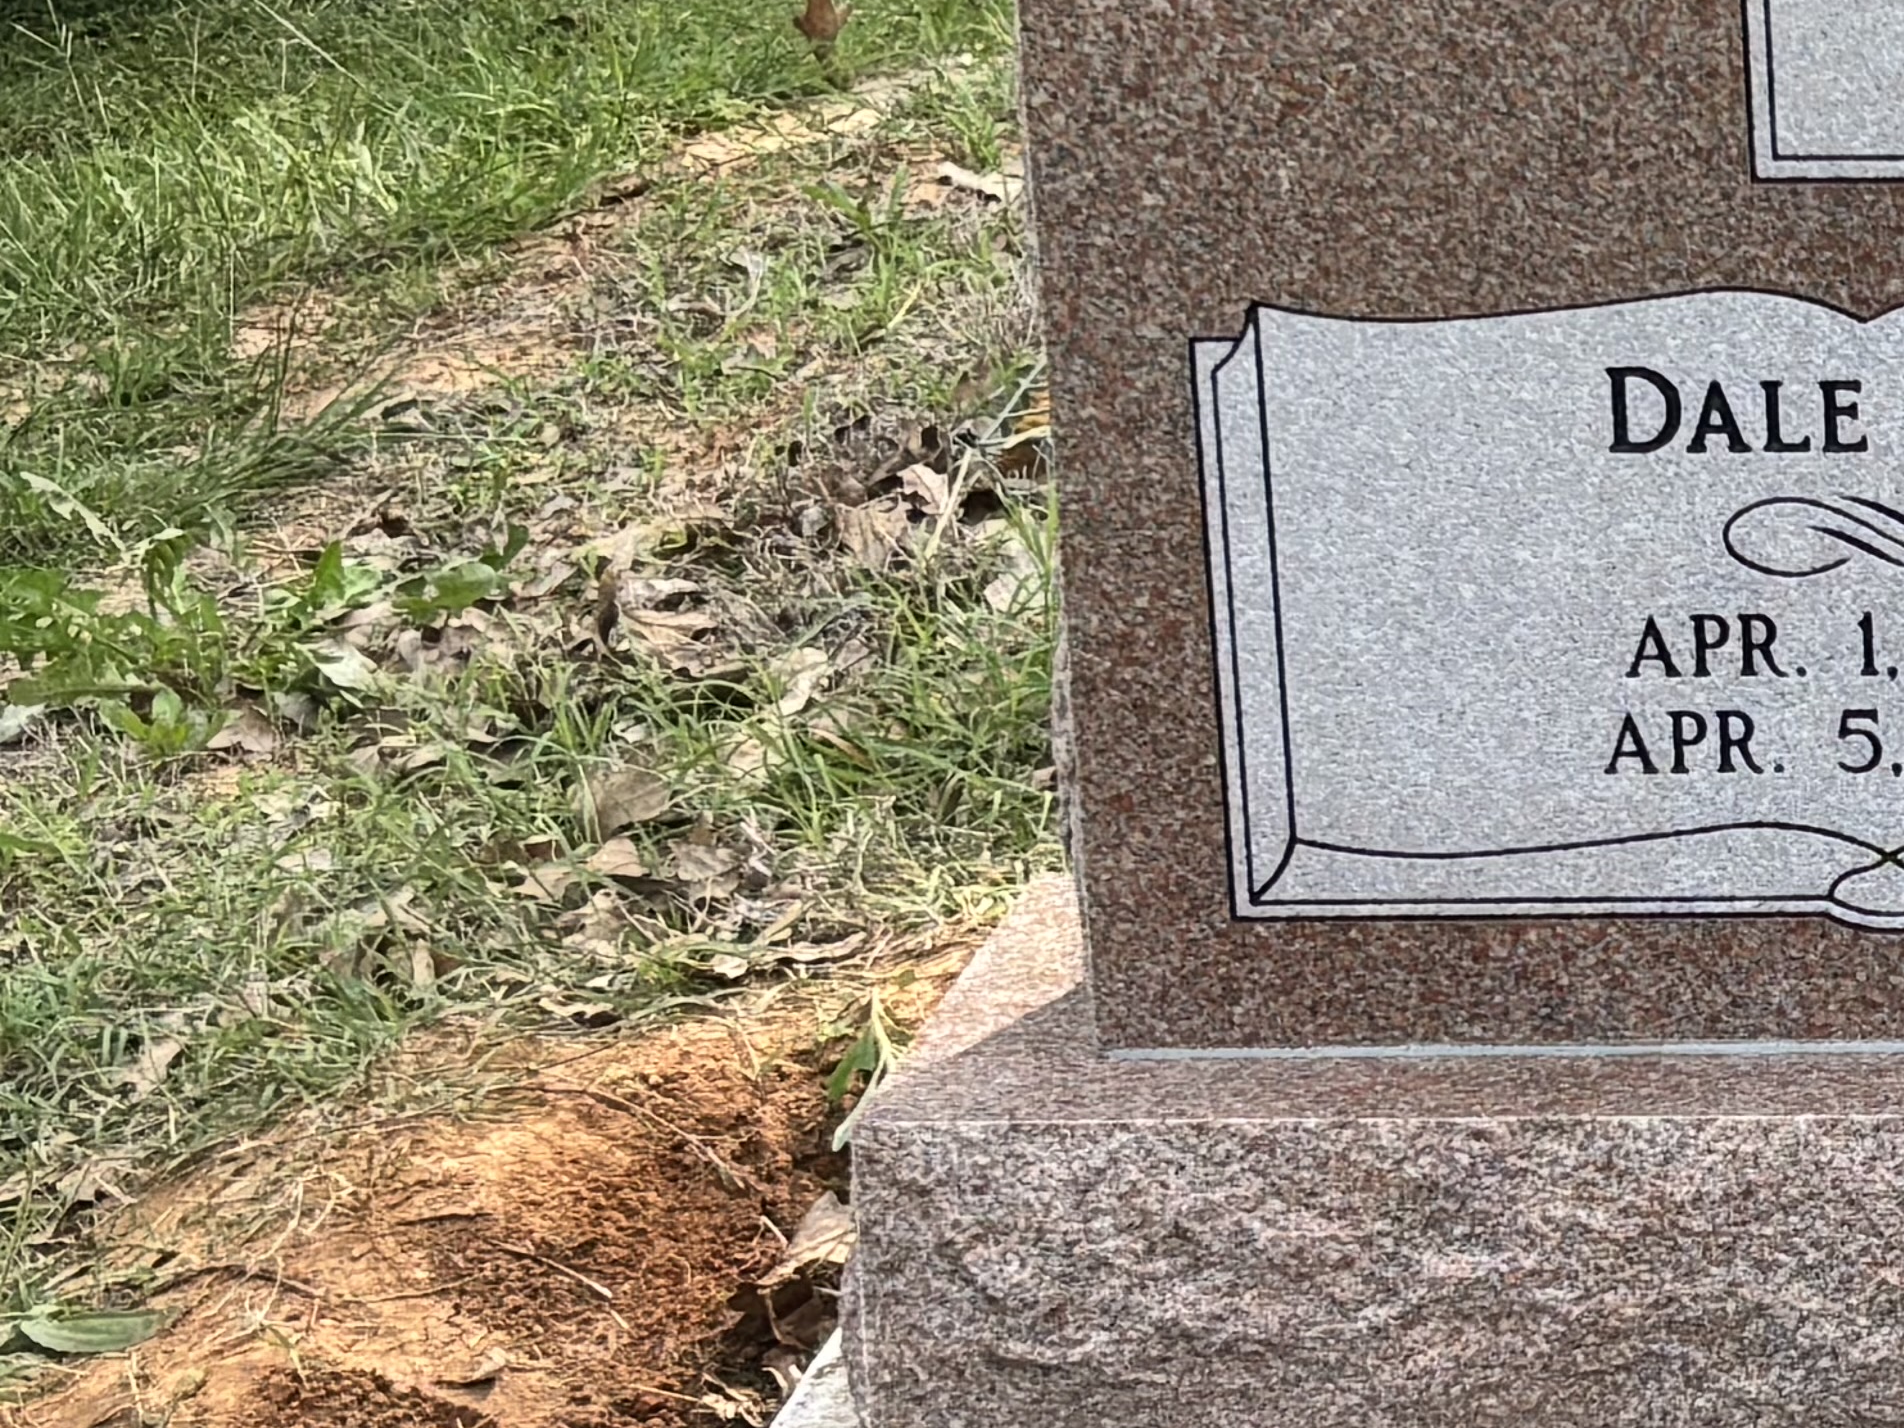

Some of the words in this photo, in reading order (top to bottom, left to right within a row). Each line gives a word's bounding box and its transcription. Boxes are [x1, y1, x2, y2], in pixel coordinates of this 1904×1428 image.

[1605, 366, 1868, 454] DALE
[1625, 613, 1807, 678] APR.
[1604, 710, 1784, 775] APR.
